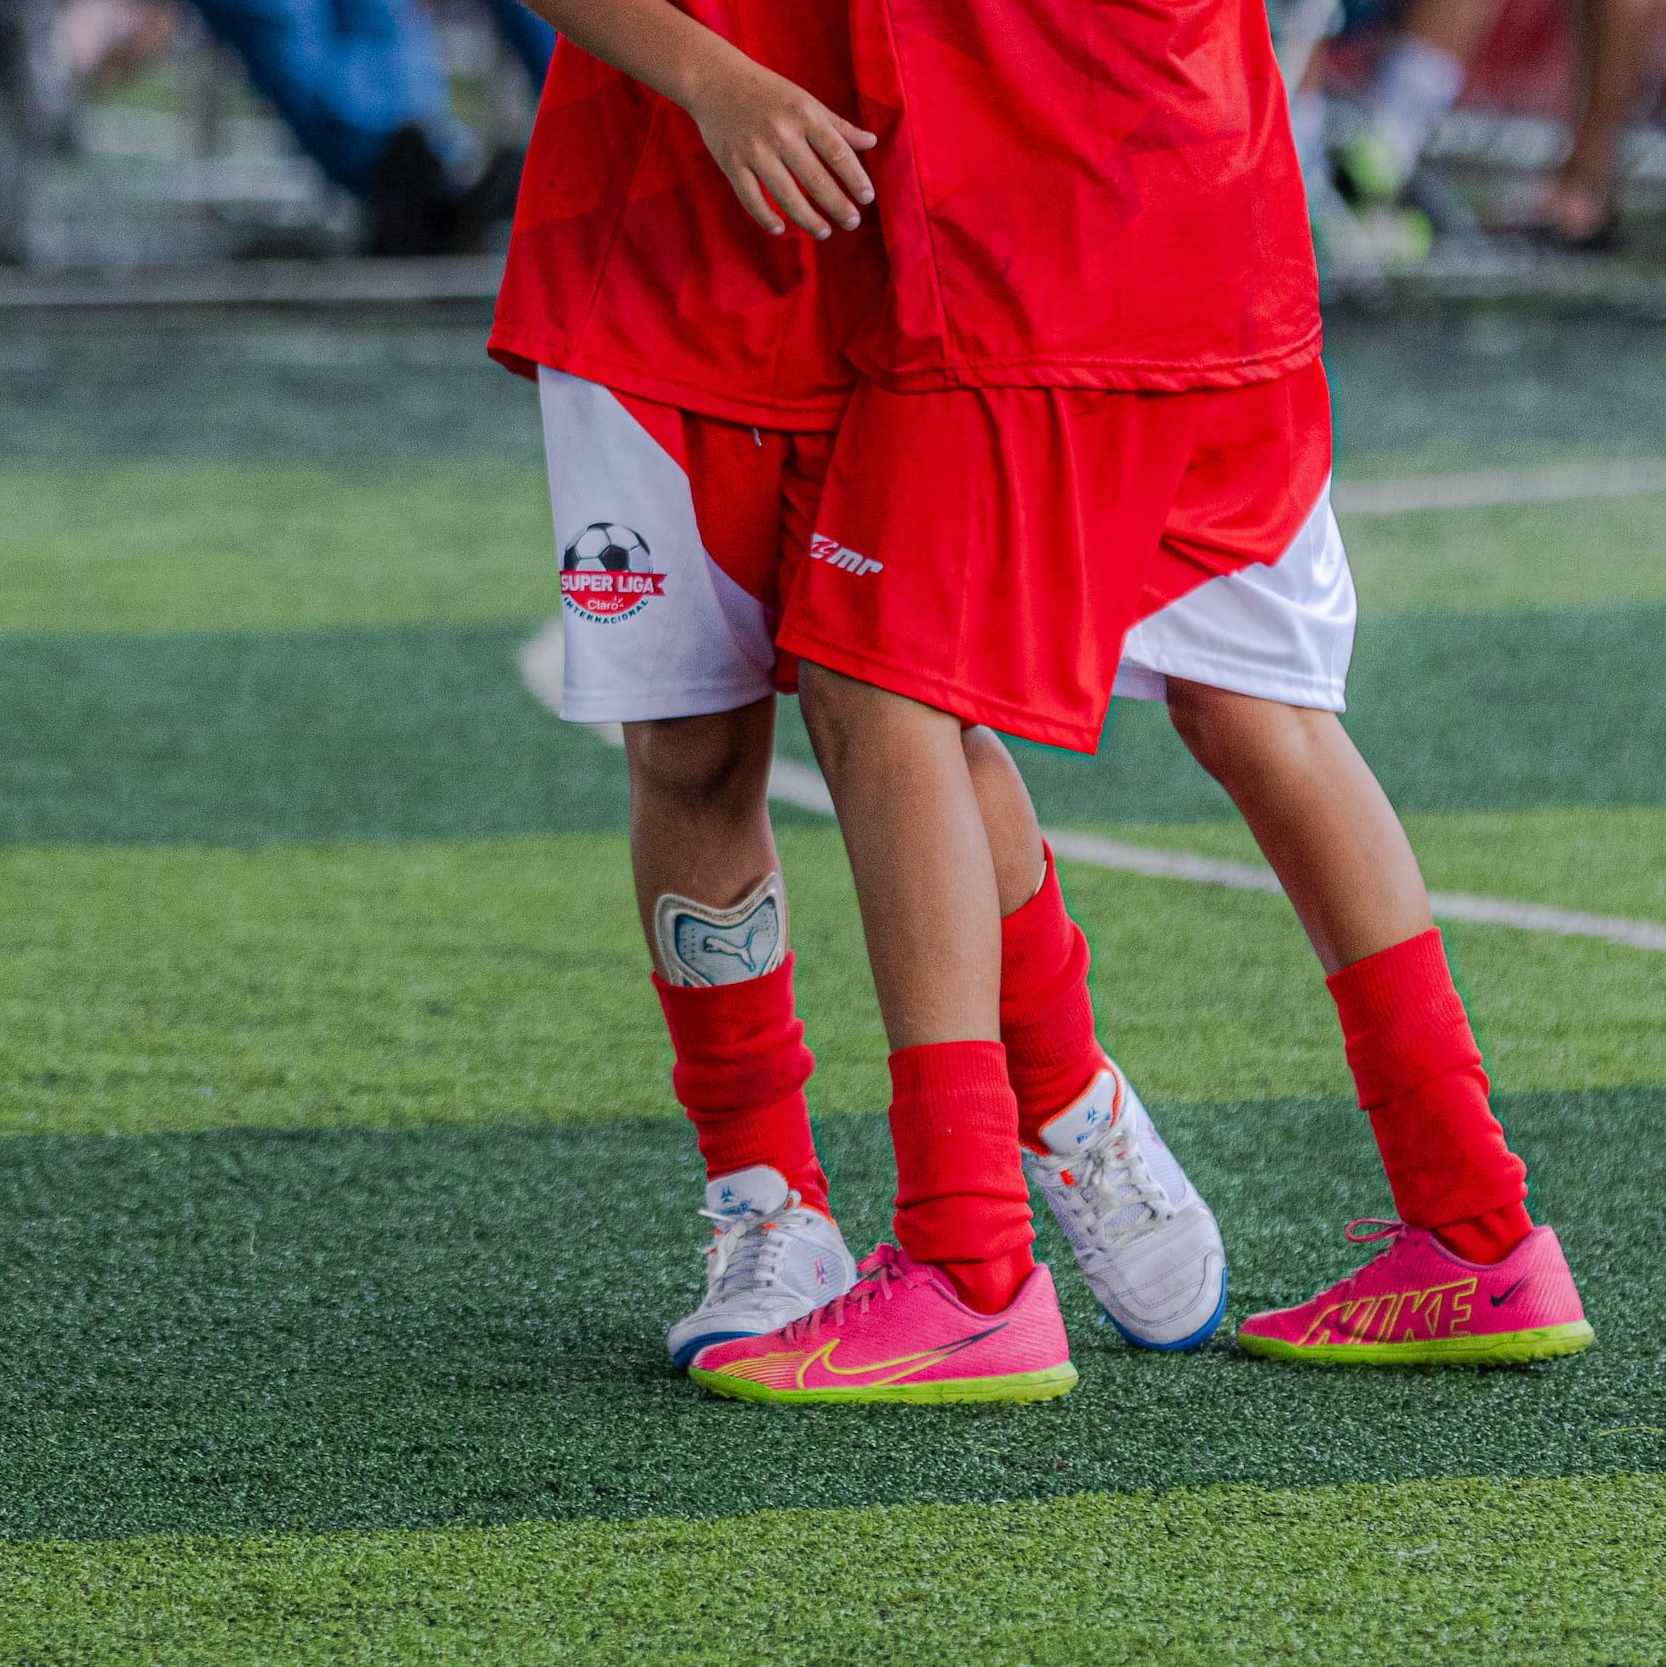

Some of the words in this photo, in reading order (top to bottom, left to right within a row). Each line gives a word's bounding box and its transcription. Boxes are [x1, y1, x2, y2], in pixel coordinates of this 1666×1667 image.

[561, 573, 614, 592] SUPER
[617, 575, 655, 594] LIGA
[563, 595, 650, 625] INTERNACIONAL
[586, 598, 620, 611] Claro
[1296, 1277, 1479, 1345] NIKE
